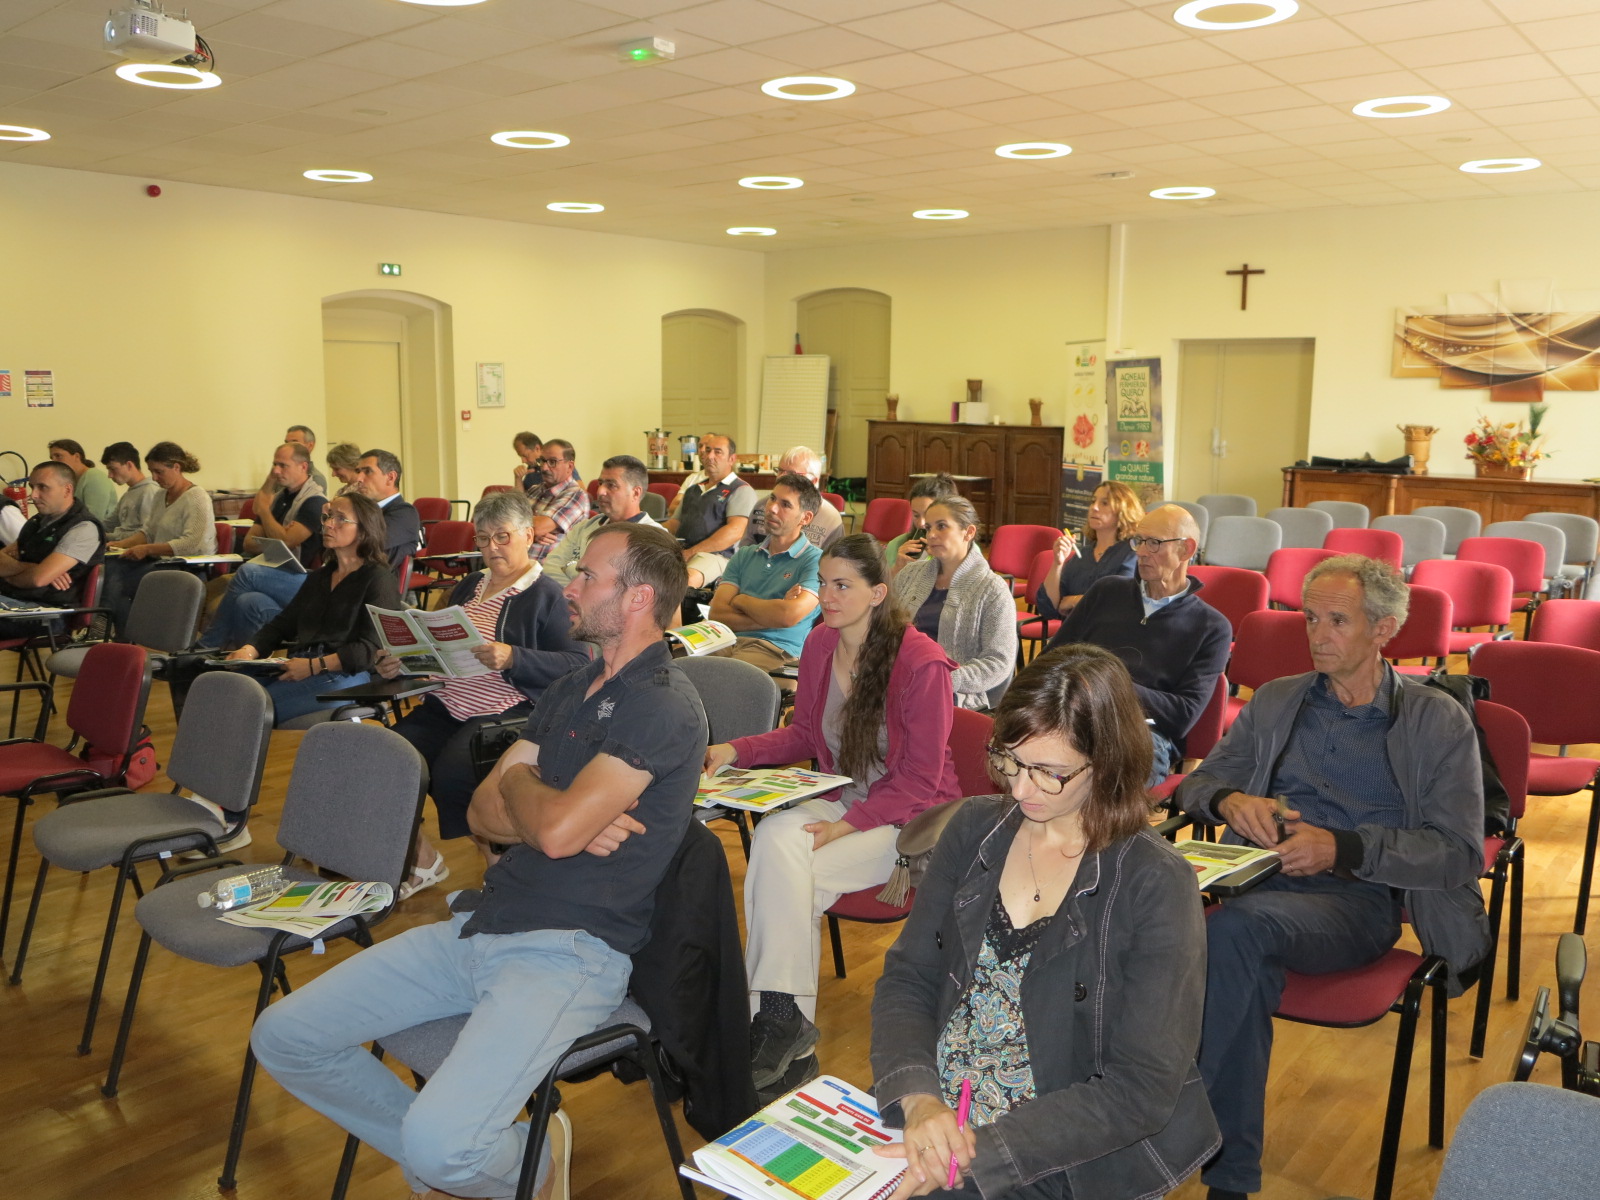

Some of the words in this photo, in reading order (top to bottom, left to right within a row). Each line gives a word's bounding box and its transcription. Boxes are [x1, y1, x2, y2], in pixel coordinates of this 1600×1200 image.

[1120, 372, 1146, 381] AGNEAU
[1119, 381, 1139, 389] FERMIER
[1120, 388, 1144, 397] QUERCY
[1115, 473, 1138, 481] grandeur
[1138, 474, 1155, 482] nature
